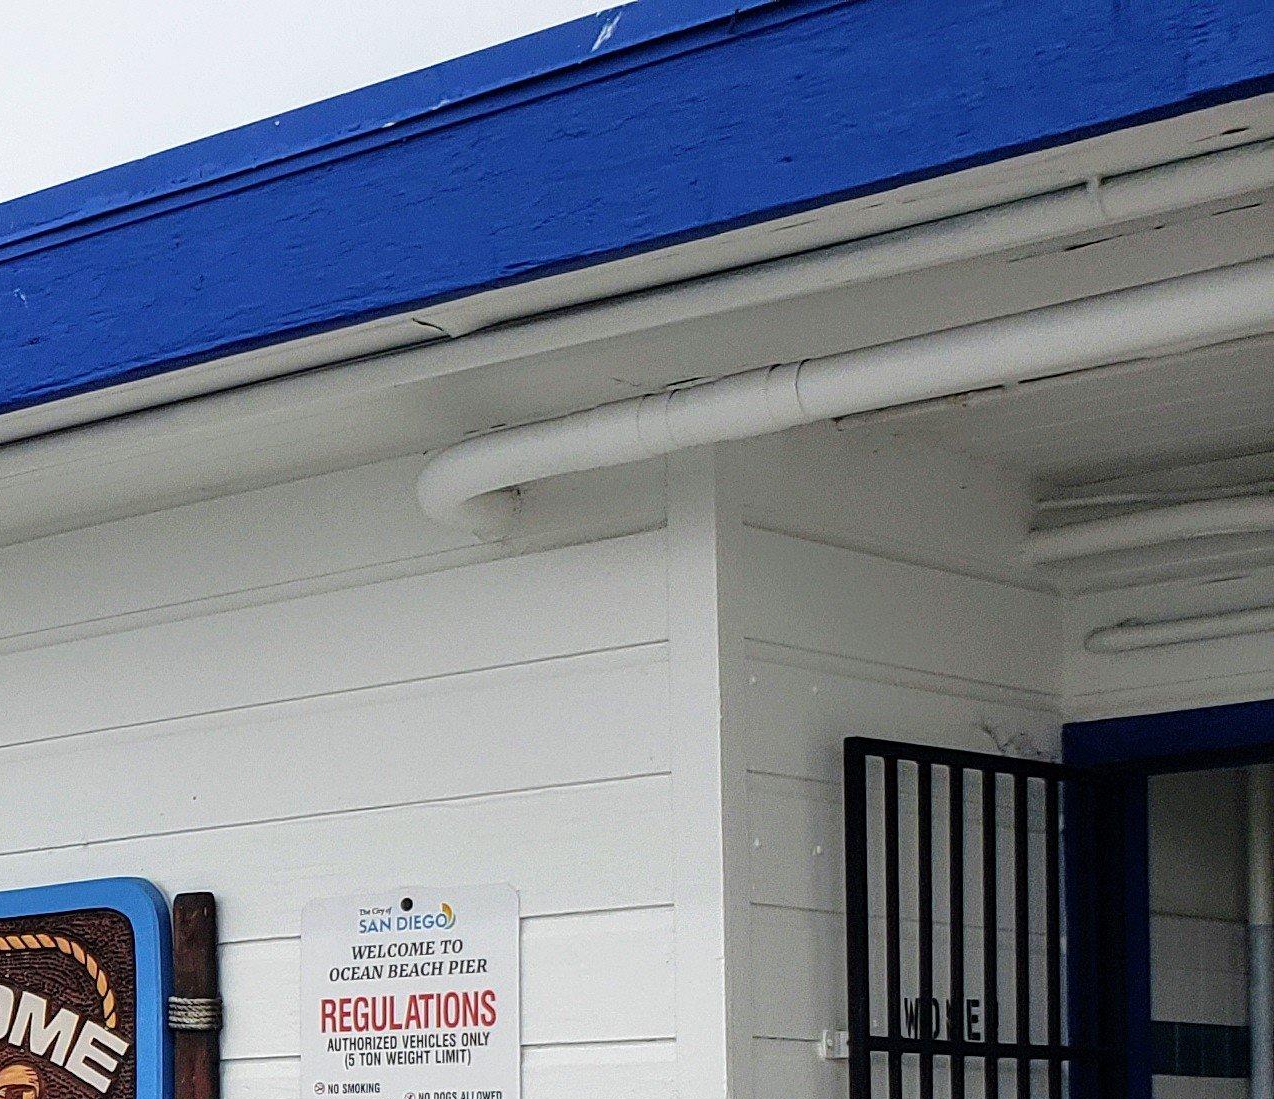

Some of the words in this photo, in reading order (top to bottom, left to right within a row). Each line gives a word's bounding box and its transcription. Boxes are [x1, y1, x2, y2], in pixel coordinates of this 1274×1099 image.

[359, 908, 370, 916] The
[372, 907, 384, 915] City
[385, 906, 392, 915] of
[359, 918, 391, 934] SAN
[397, 913, 447, 931] DIEGO
[352, 940, 435, 960] WELCOME
[441, 939, 463, 954] TO
[329, 965, 383, 982] OCEAN
[388, 961, 443, 978] BEACH
[448, 958, 487, 974] PIER
[321, 990, 497, 1033] REGULATIONS
[904, 997, 993, 1040] WOE
[327, 1036, 397, 1051] AUTHORIZED
[403, 1034, 456, 1049] VEHICLES
[462, 1032, 490, 1046] ONLY
[345, 1054, 354, 1070] (5
[360, 1052, 381, 1066] TON
[387, 1050, 430, 1065] WEIGHT
[435, 1049, 471, 1066] LIMIT)
[328, 1084, 339, 1094] NO
[342, 1083, 380, 1094] SMOKING
